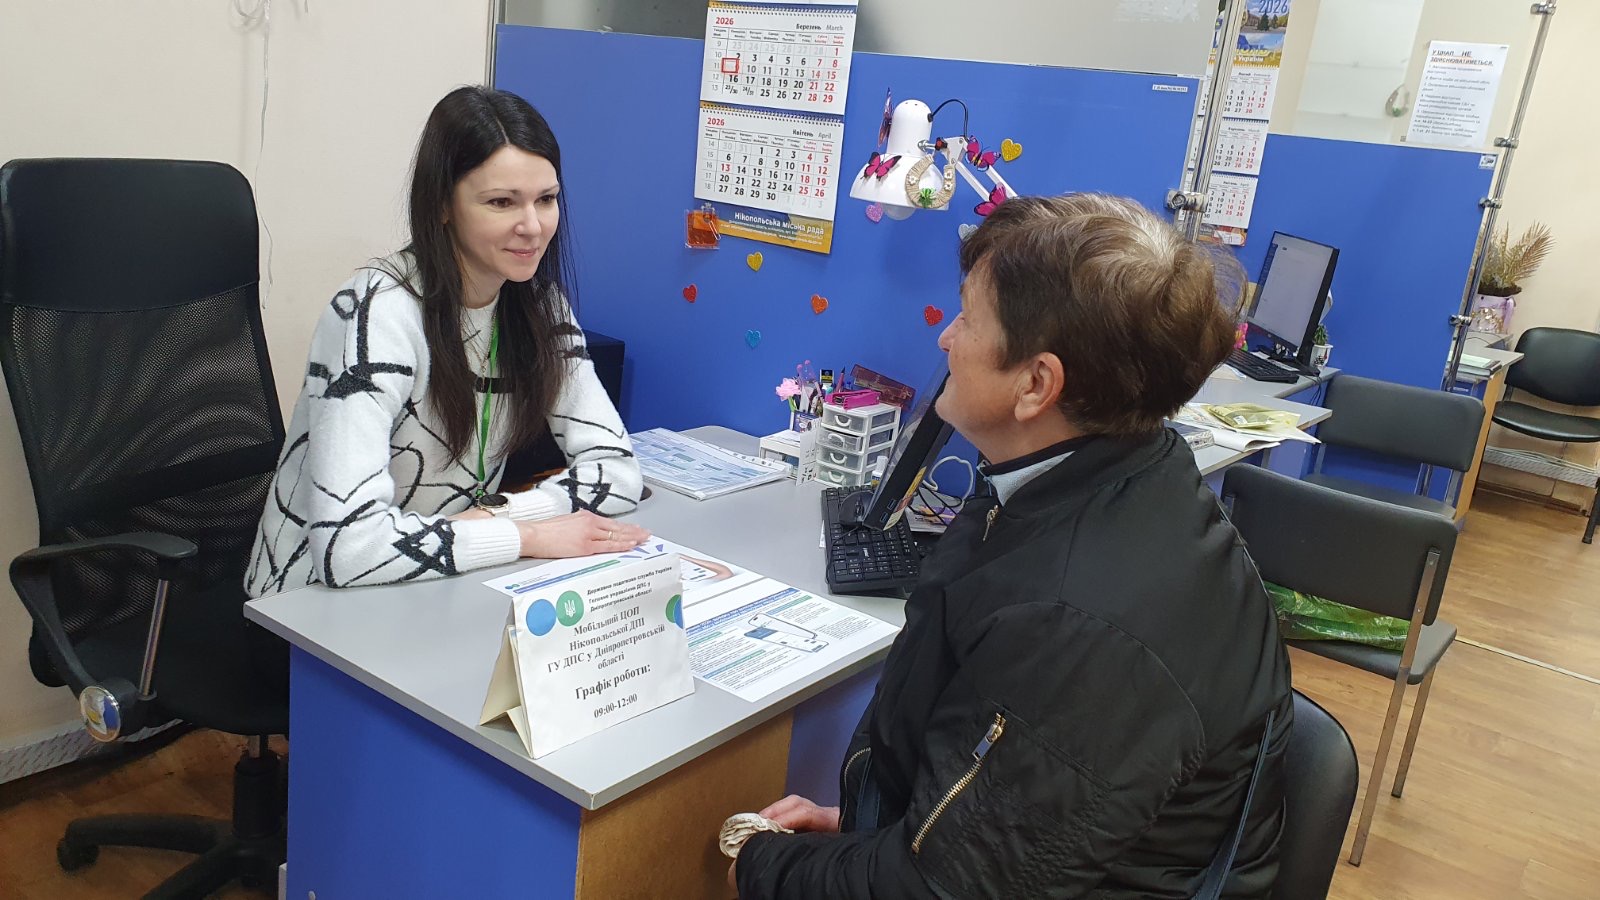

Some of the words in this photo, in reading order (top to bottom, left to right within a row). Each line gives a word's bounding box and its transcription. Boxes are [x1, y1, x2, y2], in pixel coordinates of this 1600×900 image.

[1259, 0, 1288, 13] 2026
[715, 17, 734, 25] 2026
[796, 23, 822, 31] Березень
[835, 48, 838, 56] 1
[817, 59, 822, 67] 7
[833, 59, 837, 67] 8
[747, 65, 756, 73] 10
[763, 67, 772, 75] 11
[780, 68, 789, 76] 12
[795, 69, 804, 77] 13
[812, 70, 820, 79] 14
[729, 75, 738, 83] 16
[746, 76, 755, 84] 17
[809, 82, 818, 90] 21
[825, 83, 834, 91] 22
[760, 89, 770, 97] 25
[777, 91, 787, 99] 26
[793, 92, 802, 100] 27
[808, 94, 817, 102] 28
[823, 94, 833, 103] 29
[707, 118, 725, 126] 2026
[793, 129, 814, 138] Квітень
[726, 153, 731, 161] 6
[775, 160, 779, 168] 9
[785, 161, 795, 170] 10
[801, 164, 811, 172] 11
[818, 166, 828, 175] 12
[807, 153, 812, 161] 4
[824, 154, 828, 163] 5
[721, 164, 730, 172] 13
[737, 166, 746, 174] 14
[753, 168, 762, 176] 15
[769, 171, 778, 179] 16
[784, 172, 793, 181] 17
[800, 175, 810, 183] 18
[817, 177, 826, 186] 19
[719, 185, 728, 193] 27
[735, 188, 744, 196] 28
[750, 190, 760, 198] 29
[766, 192, 776, 201] 30
[720, 174, 729, 183] 20
[736, 177, 744, 185] 21
[752, 179, 761, 187] 22
[767, 182, 777, 190] 23
[783, 183, 792, 192] 24
[799, 186, 809, 195] 25
[815, 188, 825, 197] 26
[734, 212, 781, 227] Нікопольська
[807, 225, 824, 235] рада
[635, 589, 652, 597] області
[573, 615, 620, 636] Мобільний
[620, 606, 640, 623] ЦОП
[569, 624, 629, 652] Нікопольської
[630, 617, 645, 632] ДПІ
[547, 660, 561, 674] ГУ
[563, 653, 585, 669] ДПС
[587, 653, 593, 663] у
[595, 624, 666, 657] Дніпропетровській
[598, 653, 625, 671] області
[575, 678, 612, 701] Графік
[613, 664, 651, 688] роботи:
[593, 693, 638, 719] 09:00-12:00
